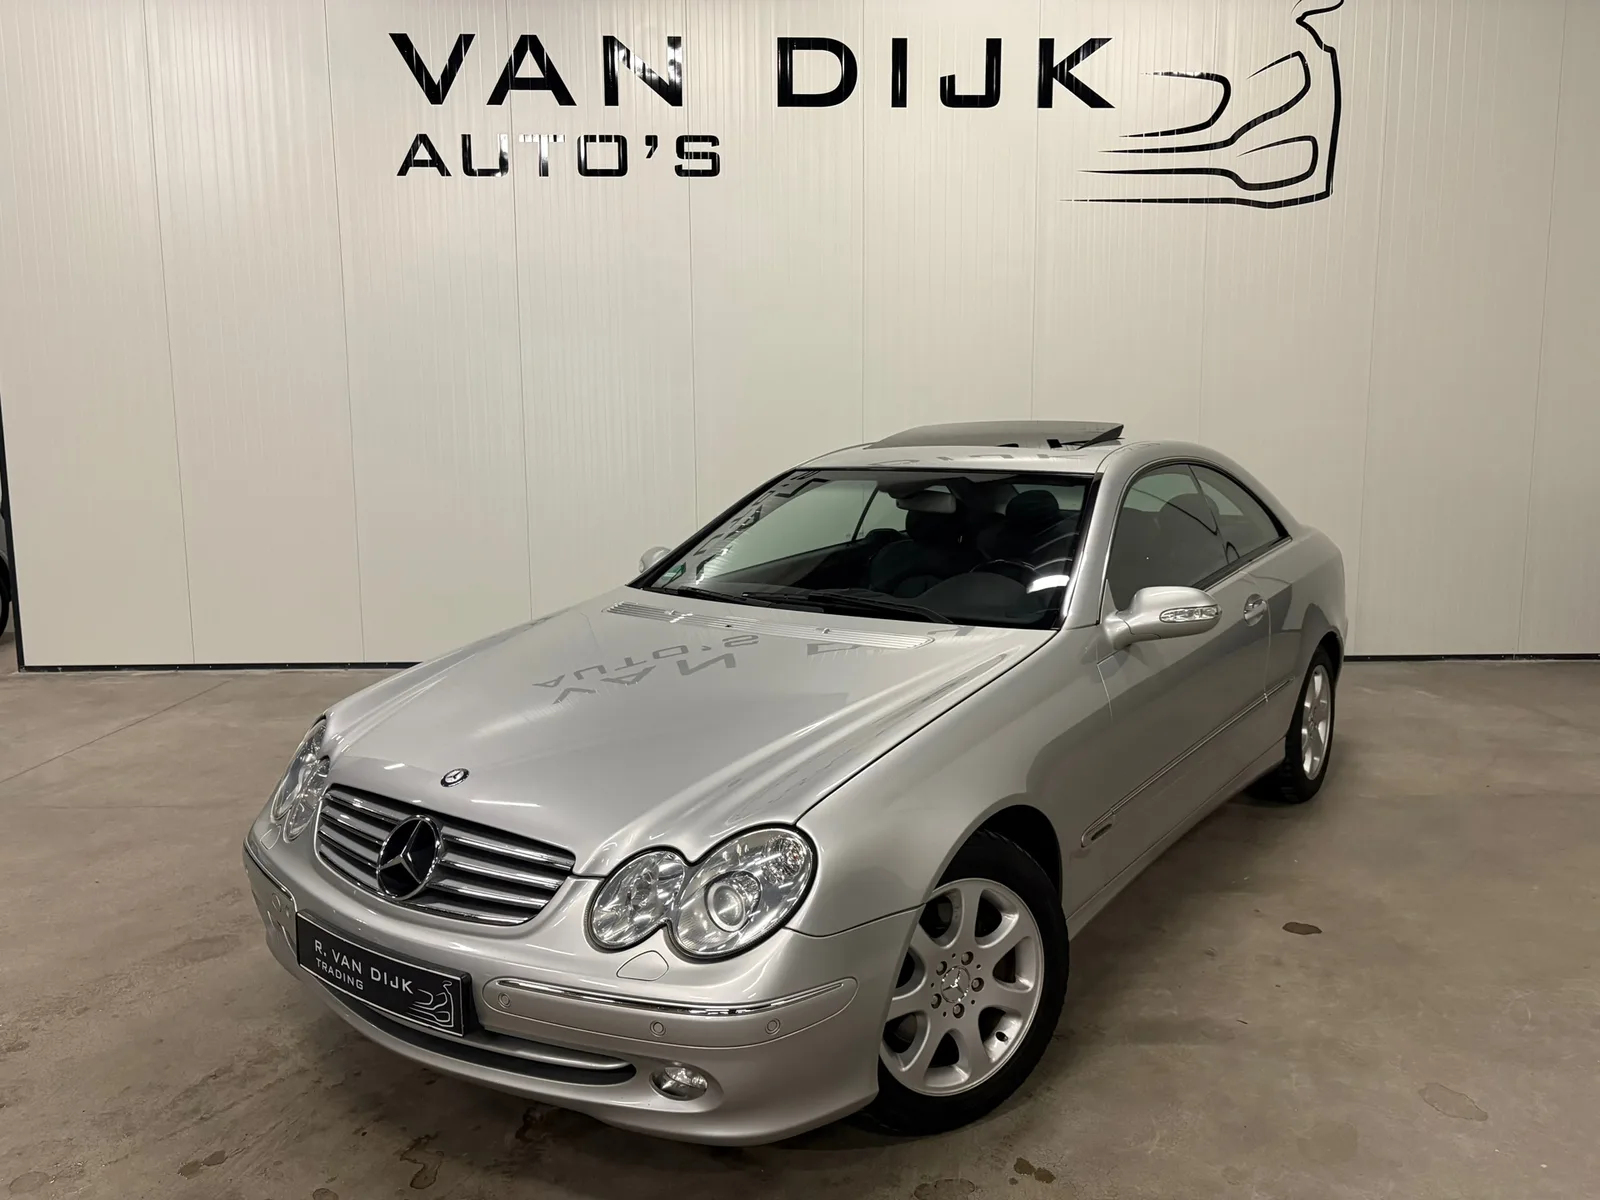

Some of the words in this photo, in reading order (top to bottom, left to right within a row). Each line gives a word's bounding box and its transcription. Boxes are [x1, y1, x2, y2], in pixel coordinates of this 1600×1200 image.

[389, 33, 682, 106] VAN
[777, 37, 1115, 108] DIJK
[397, 133, 720, 177] AUTO'S
[315, 940, 327, 957] R.
[332, 949, 361, 974] VAN
[371, 967, 413, 995] DIJK
[315, 957, 364, 991] TRADING
